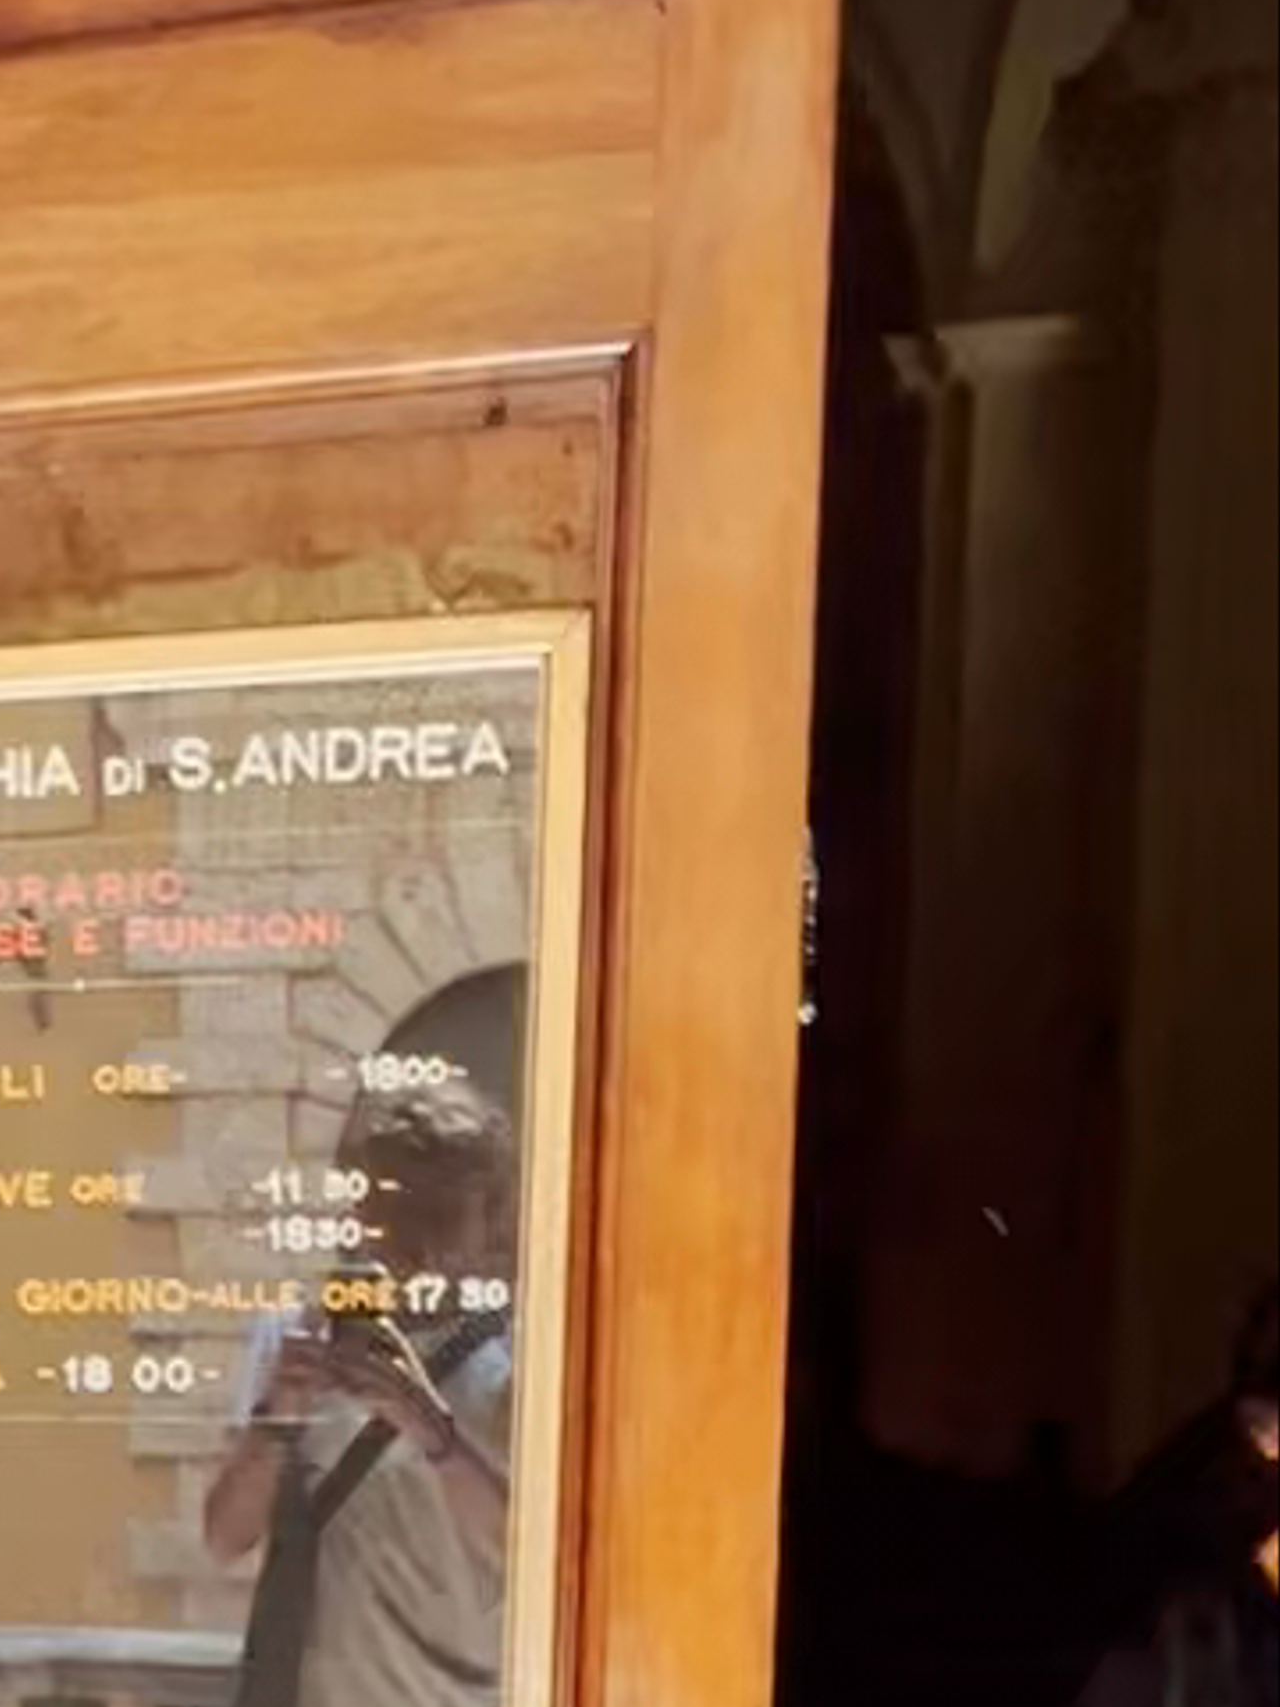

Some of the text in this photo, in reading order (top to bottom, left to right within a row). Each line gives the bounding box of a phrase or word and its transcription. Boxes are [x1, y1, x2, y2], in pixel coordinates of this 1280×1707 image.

[71, 918, 100, 955] E
[123, 910, 347, 953] FUNZIONI
[69, 1171, 144, 1204] ORE
[321, 1279, 397, 1314] ORE
